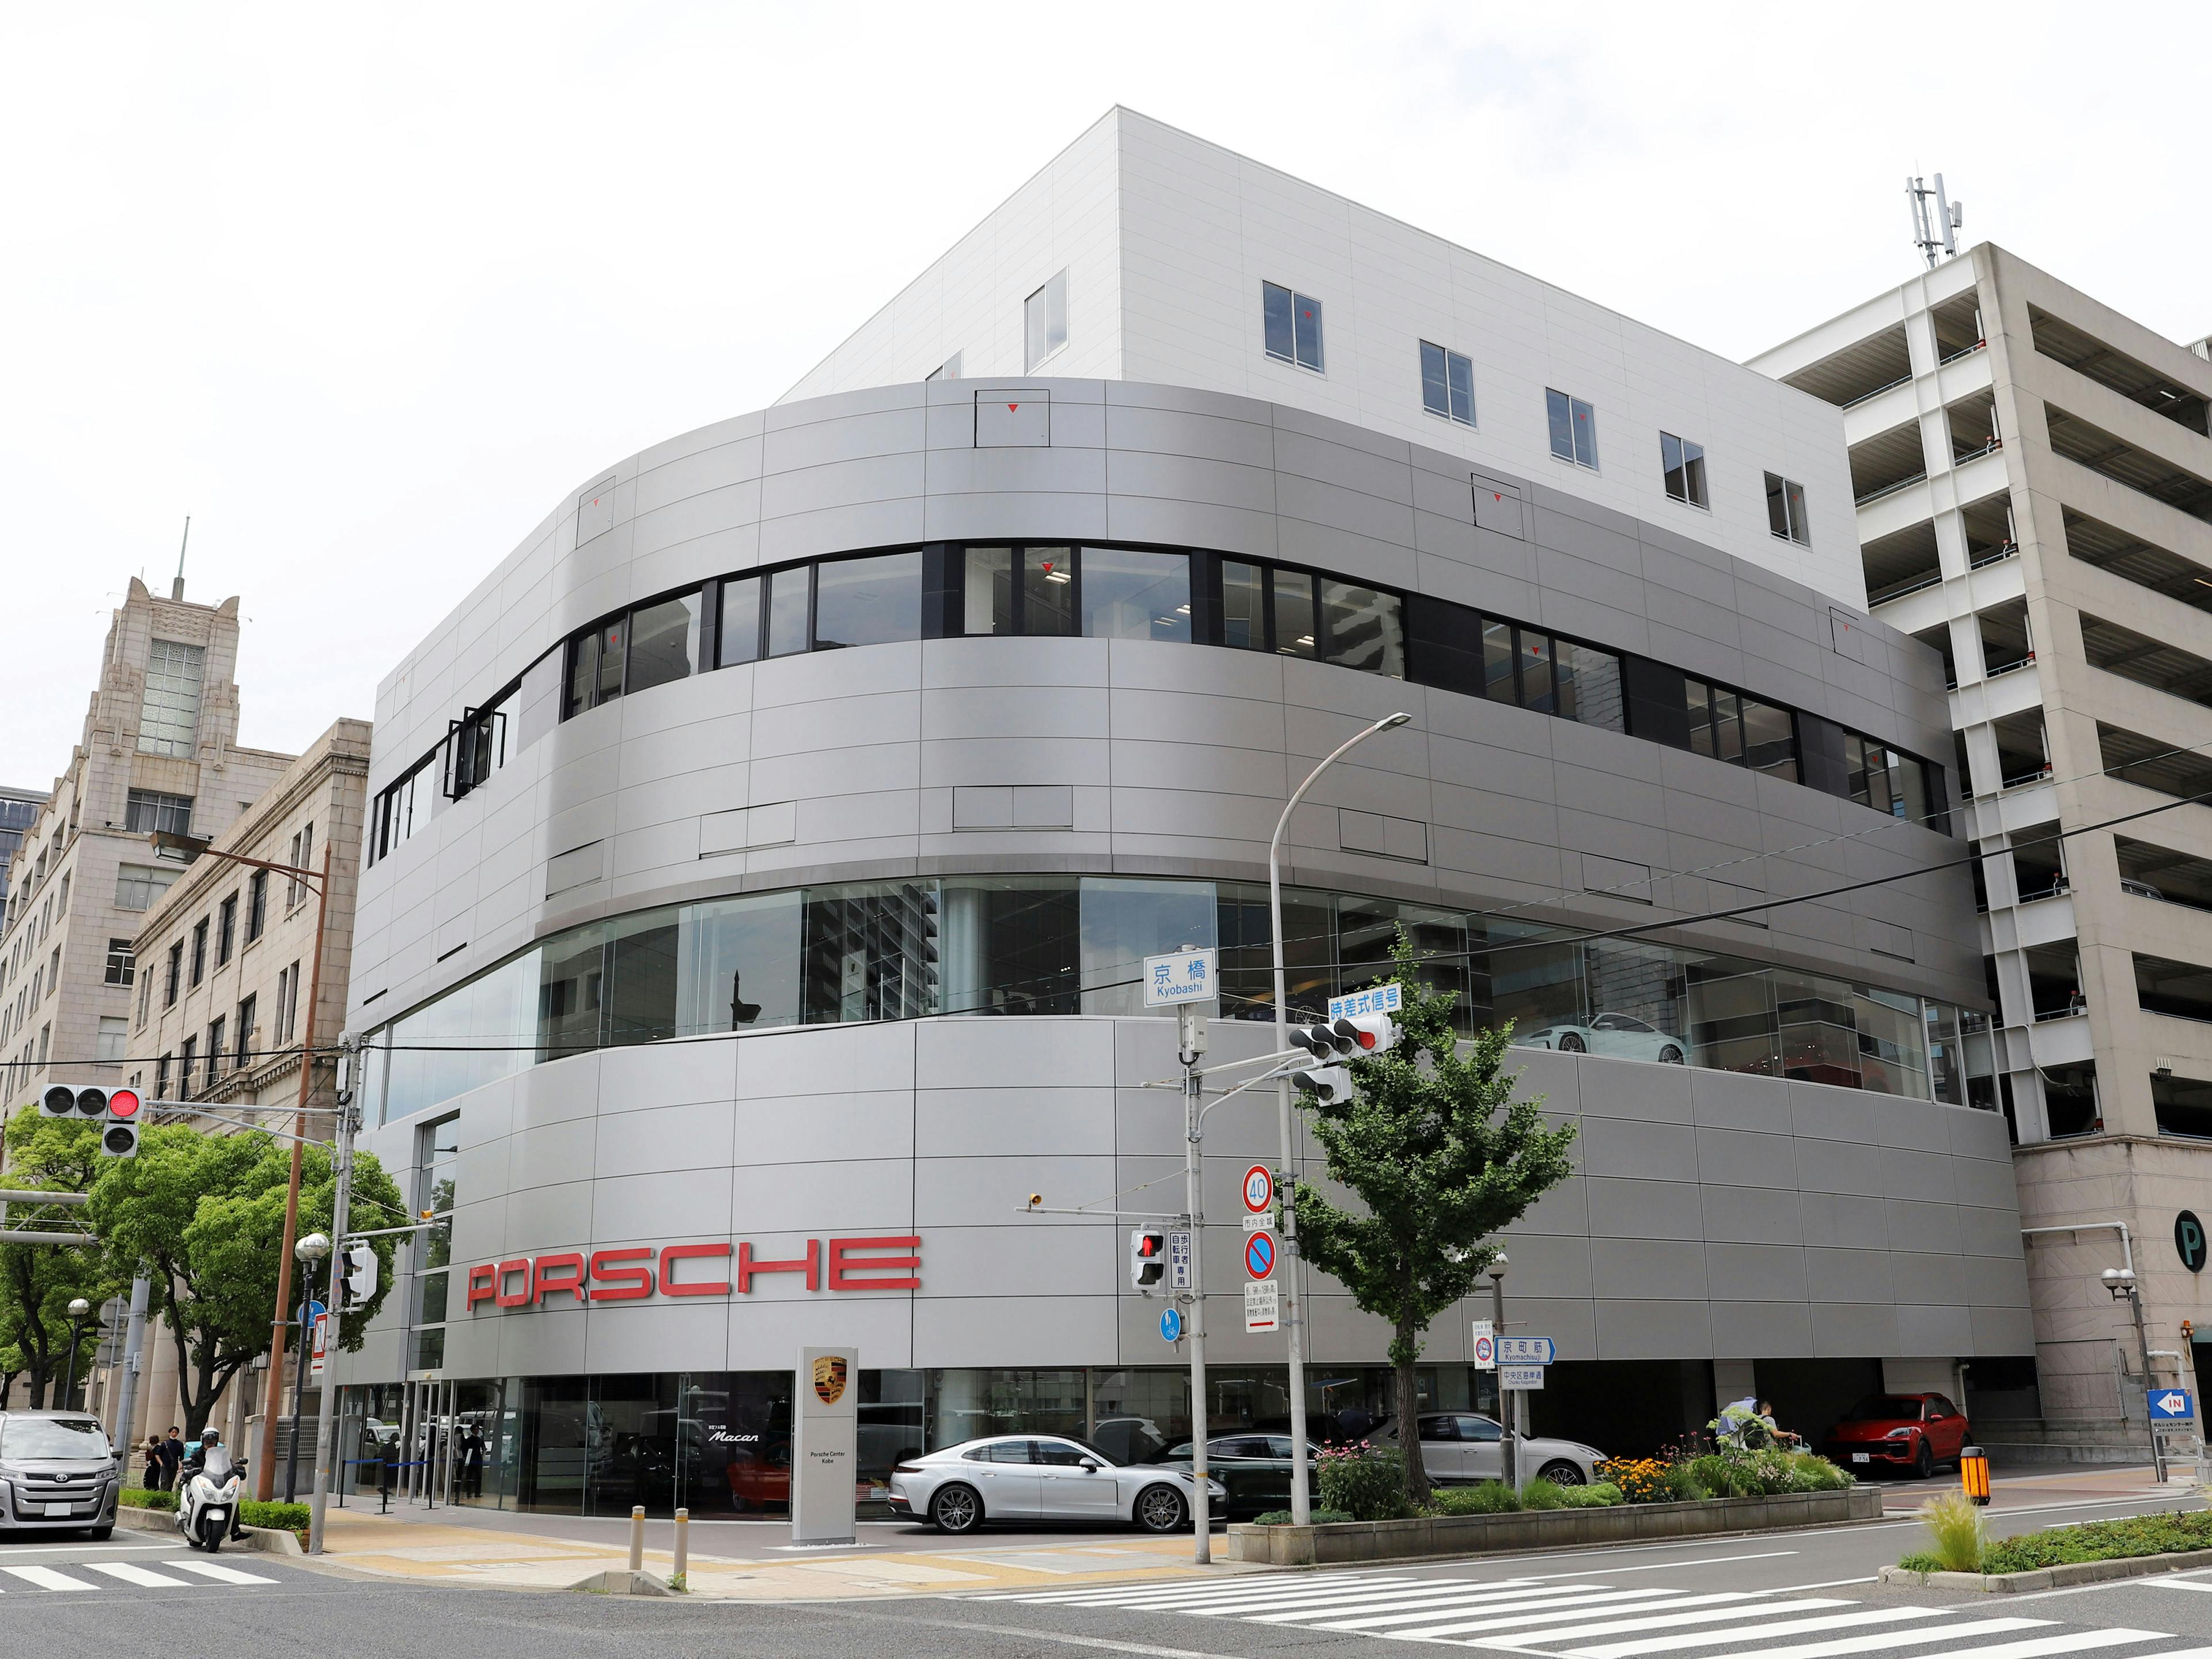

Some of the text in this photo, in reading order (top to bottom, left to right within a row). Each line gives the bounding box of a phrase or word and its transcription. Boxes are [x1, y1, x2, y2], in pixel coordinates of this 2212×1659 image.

[1153, 959, 1206, 984] 京橋
[1157, 981, 1202, 998] Kyobashi
[1331, 988, 1398, 1020] 時差式信号
[1249, 1179, 1266, 1199] 40
[1245, 1217, 1272, 1228] 市内全域
[1180, 1235, 1188, 1264] 歩行者
[2181, 1221, 2200, 1265] P
[467, 1236, 921, 1311] PORSCHE
[1177, 1266, 1185, 1286] 専用
[1503, 1340, 1542, 1353] 京町筋
[1503, 1371, 1541, 1380] 中央区海岸通
[2169, 1400, 2181, 1408] IN
[708, 1431, 759, 1441] Macan
